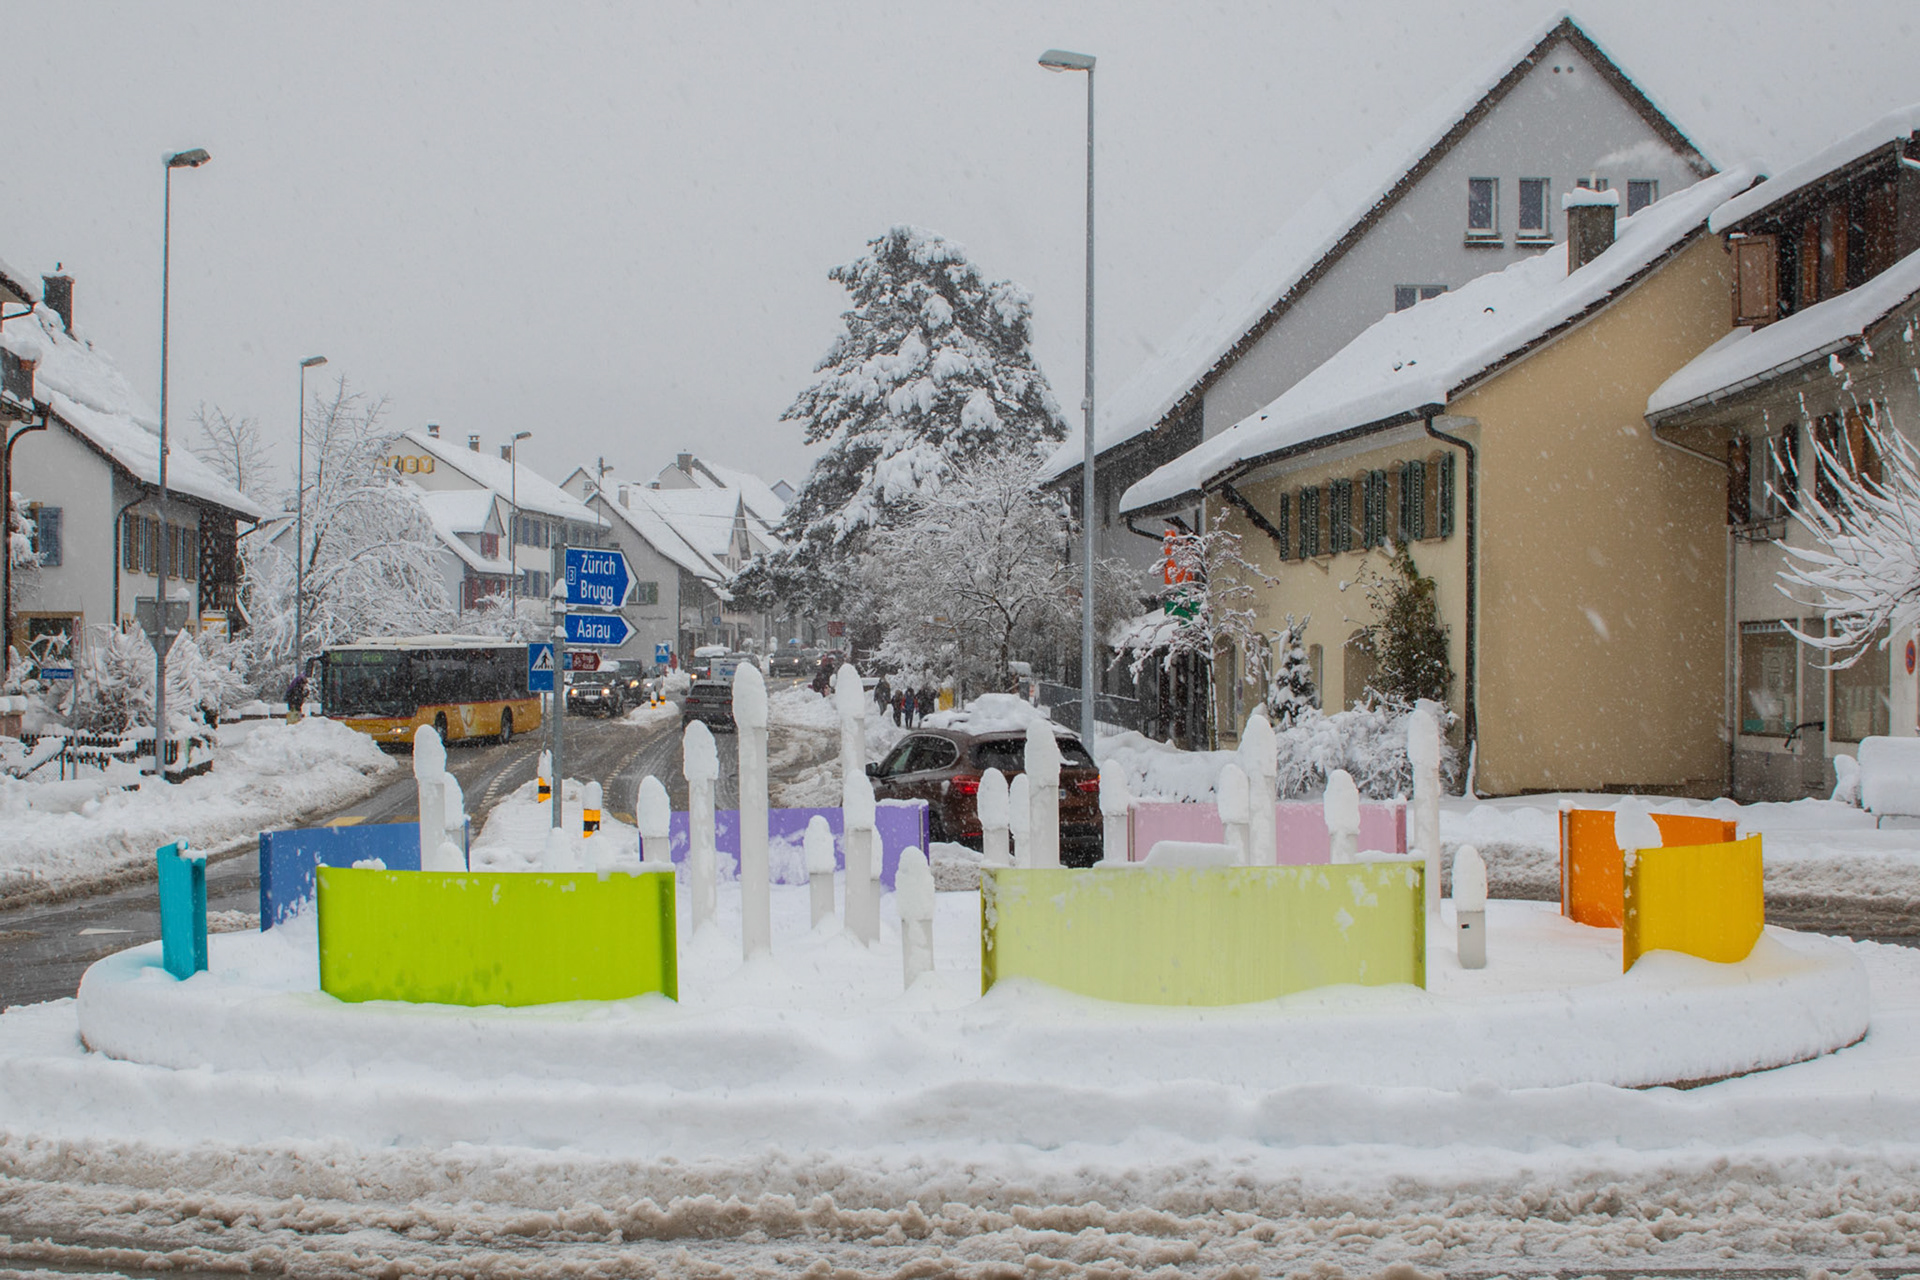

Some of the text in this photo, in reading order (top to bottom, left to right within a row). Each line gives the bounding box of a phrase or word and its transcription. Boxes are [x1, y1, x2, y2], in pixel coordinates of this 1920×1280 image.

[581, 554, 616, 575] Zürich
[569, 569, 574, 582] 3
[580, 580, 614, 605] Brugg
[576, 619, 611, 639] Aarau
